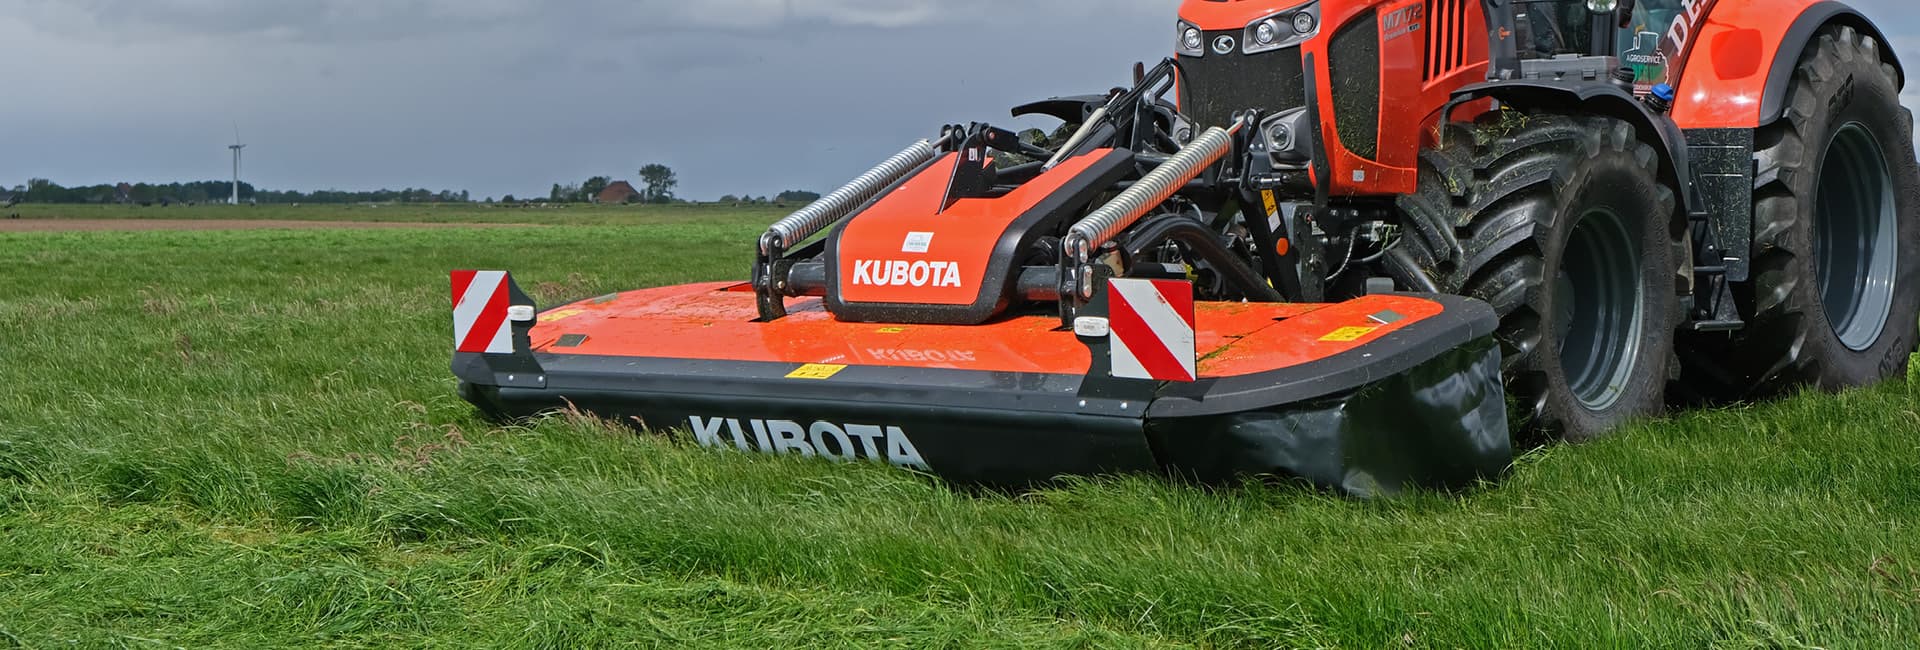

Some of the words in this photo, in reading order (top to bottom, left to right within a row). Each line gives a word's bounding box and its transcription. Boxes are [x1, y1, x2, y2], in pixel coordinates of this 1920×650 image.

[1626, 53, 1661, 64] AGROSERVICE
[852, 259, 962, 287] KUBOTA
[689, 415, 933, 472] KUBOTA
